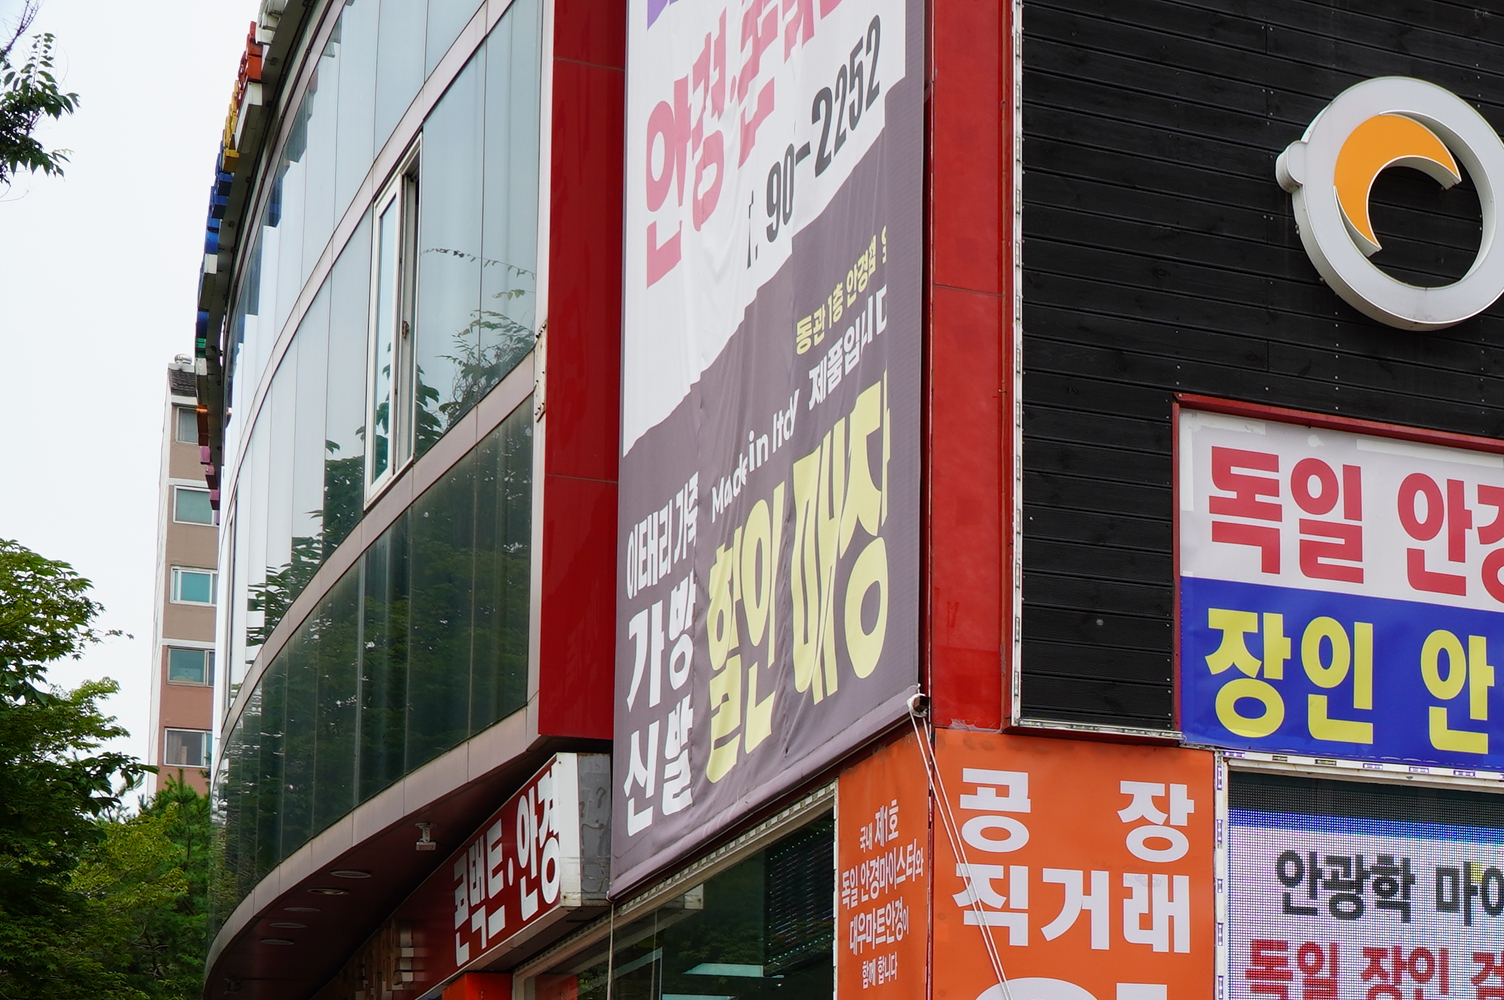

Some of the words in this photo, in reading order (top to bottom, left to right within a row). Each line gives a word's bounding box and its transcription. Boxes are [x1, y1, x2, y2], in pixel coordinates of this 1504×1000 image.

[796, 303, 826, 355] 동관
[712, 453, 748, 523] Made
[749, 430, 768, 472] in
[1209, 445, 1364, 584] 독일
[626, 499, 673, 600] 이태리
[627, 571, 697, 713] 가방
[706, 482, 785, 783] 할인
[1205, 608, 1374, 745] 장인
[623, 694, 694, 837] 신발
[860, 822, 873, 853] 국내
[874, 799, 899, 847] 제1호
[842, 865, 858, 910] 독일
[860, 838, 925, 903] 안경마이스터와
[952, 863, 1191, 954] 직거래
[1276, 849, 1415, 923] 안광학
[849, 896, 910, 956] 대우마트안경이
[862, 957, 876, 989] 함께
[877, 951, 898, 985] 합니다
